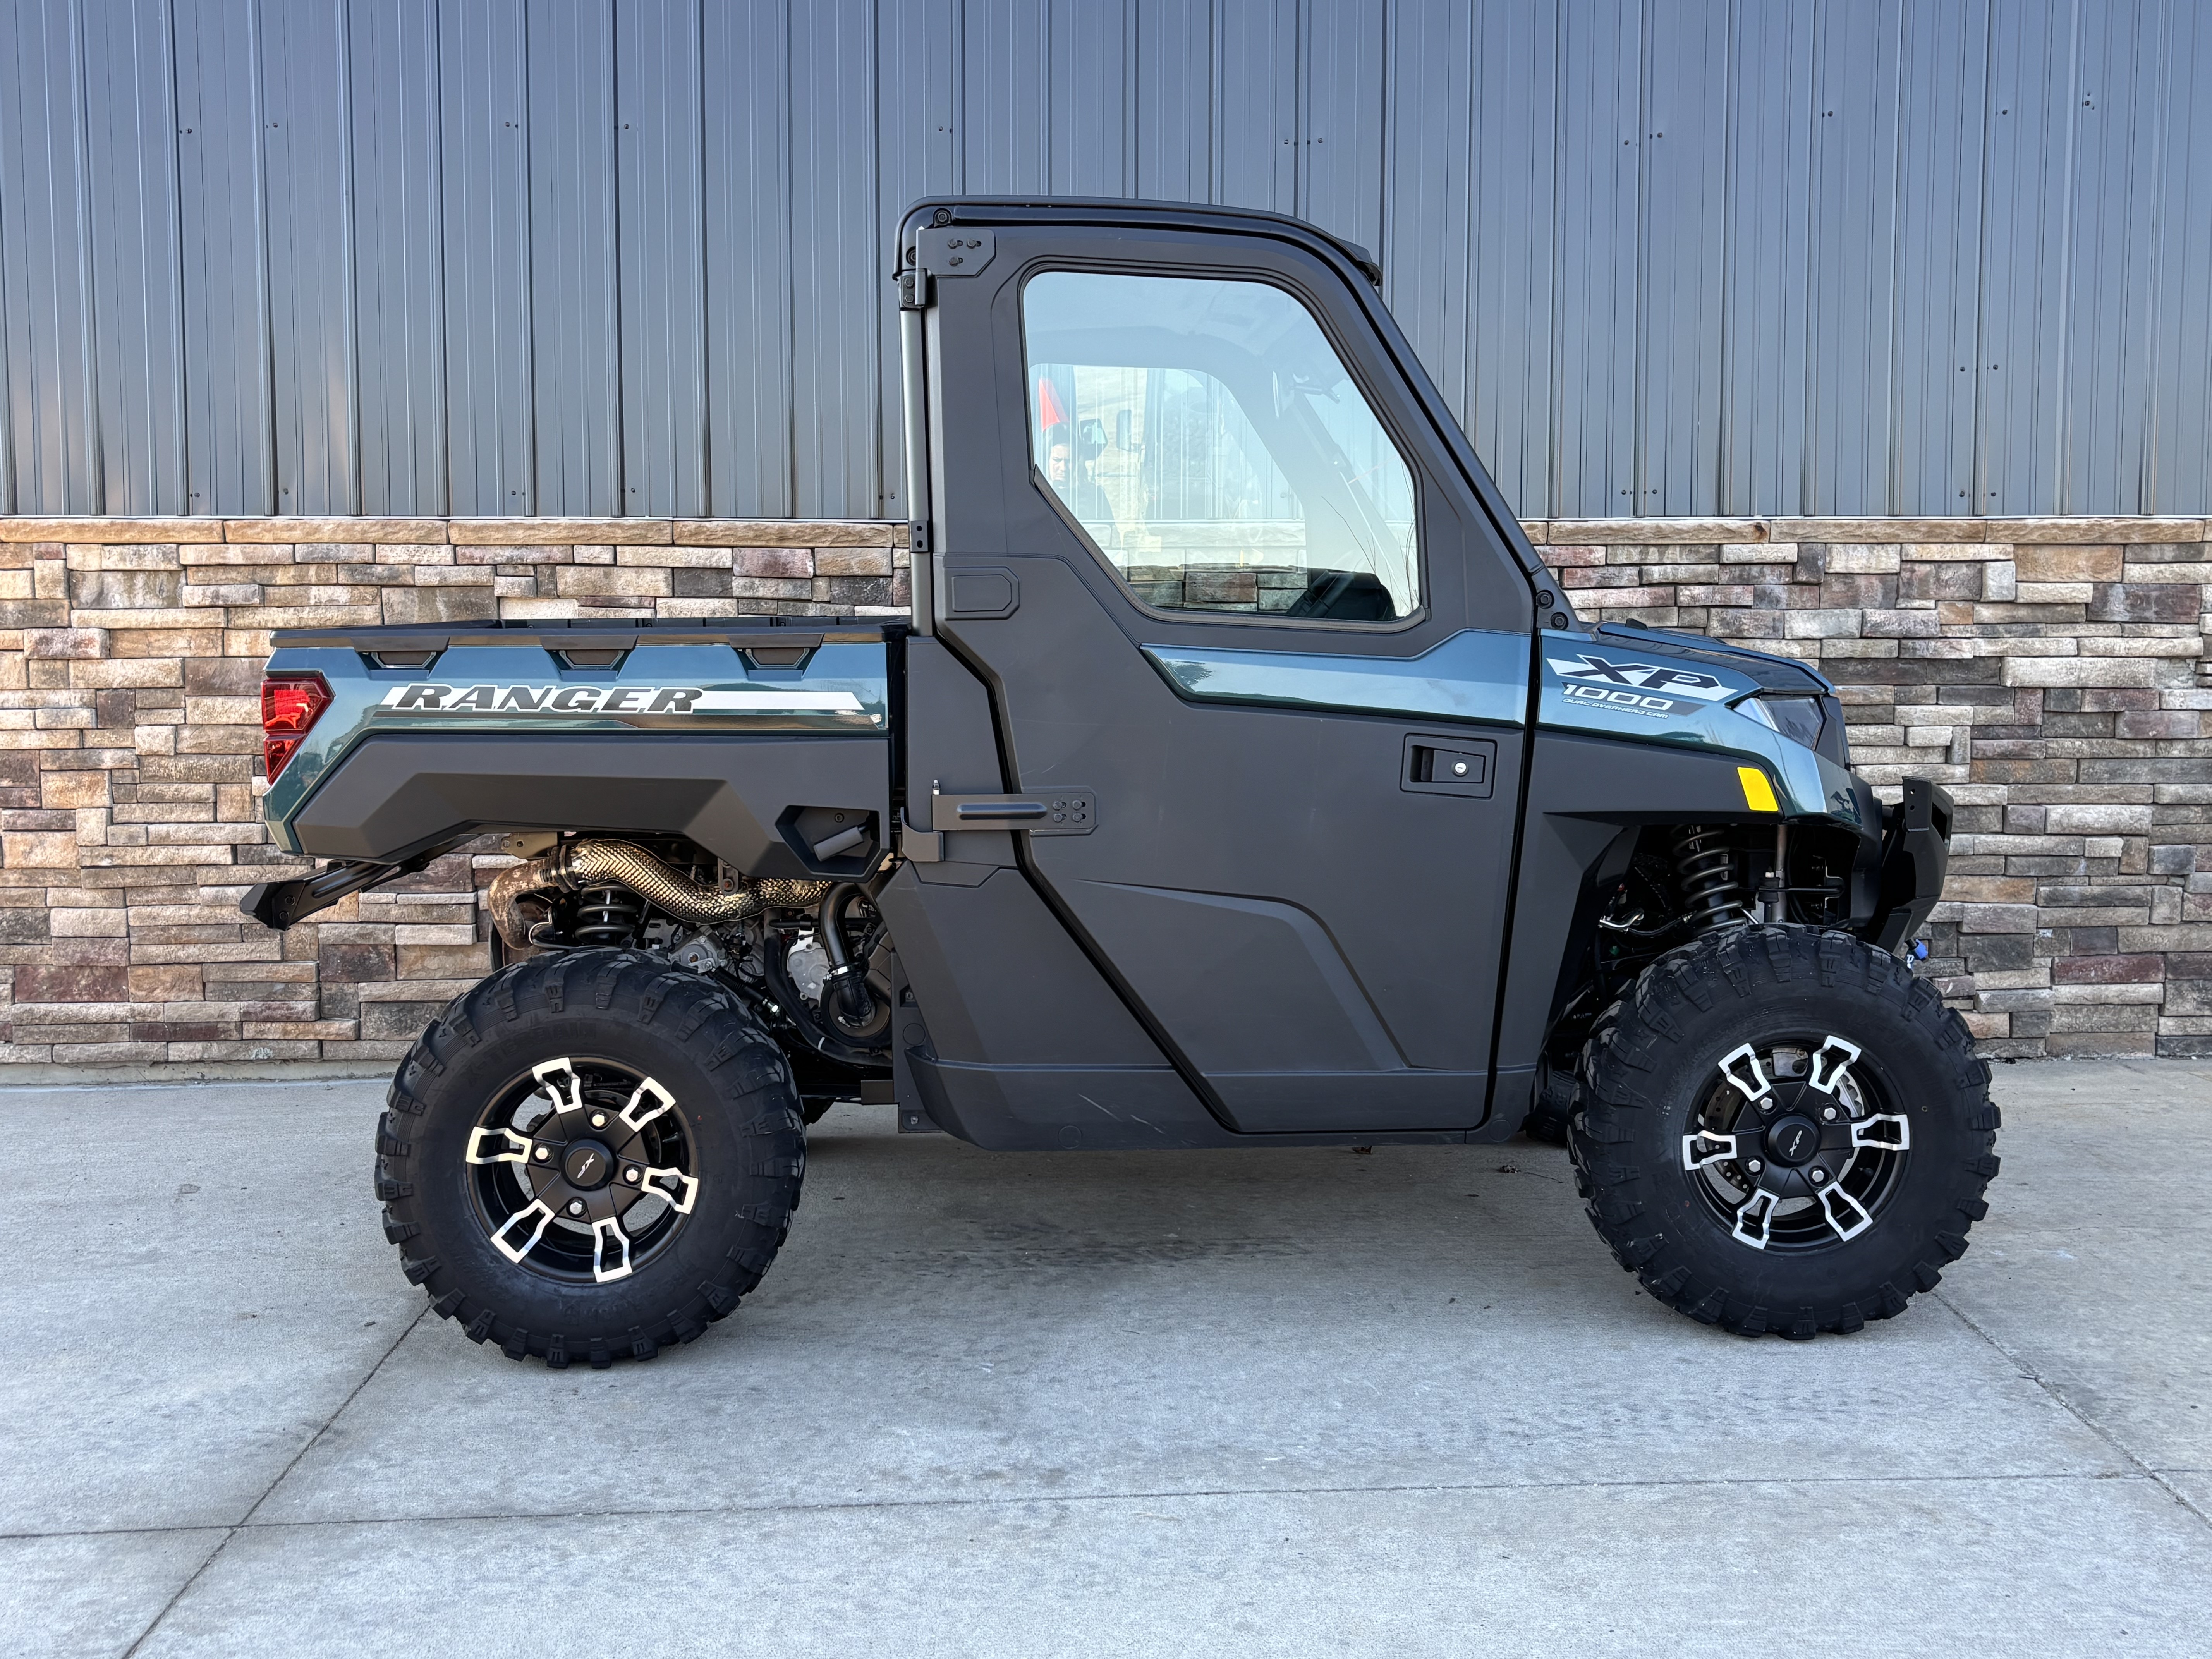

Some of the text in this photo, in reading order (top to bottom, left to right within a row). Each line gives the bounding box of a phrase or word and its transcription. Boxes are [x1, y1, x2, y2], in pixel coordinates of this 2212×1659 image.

[1558, 654, 1722, 689] XP
[392, 683, 703, 714] RANGER
[1563, 684, 1674, 711] 1000
[1789, 1130, 1802, 1157] XP
[577, 1153, 594, 1178] XP
